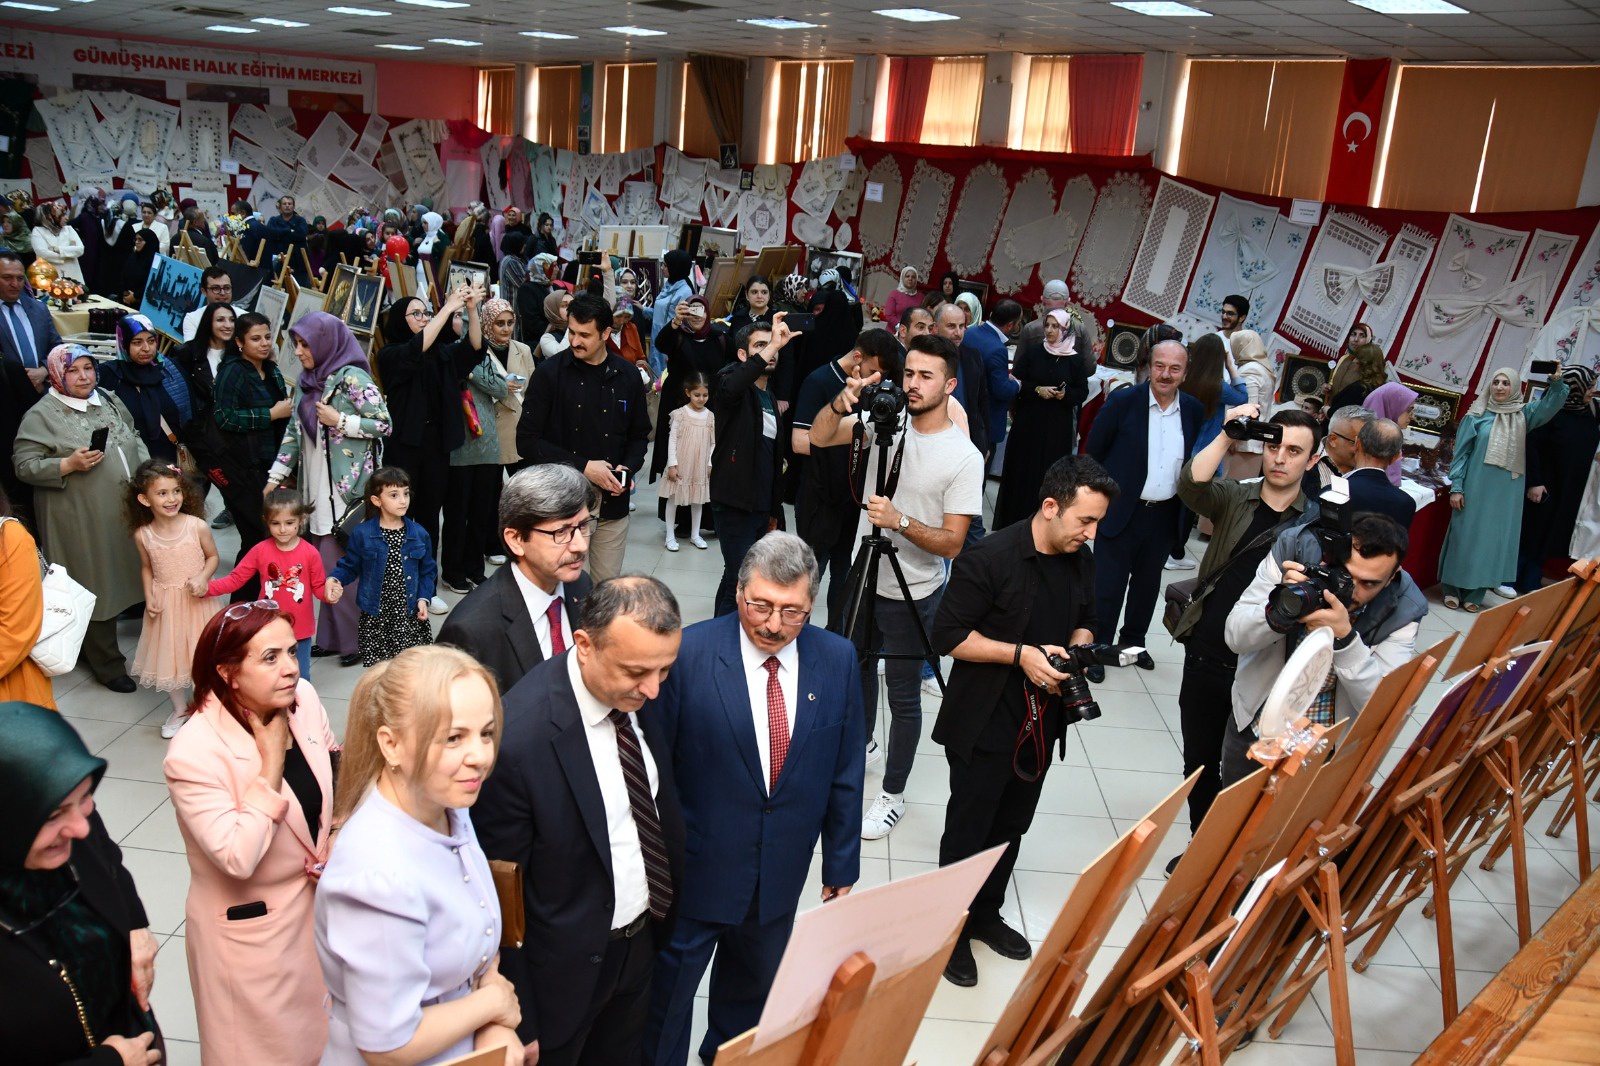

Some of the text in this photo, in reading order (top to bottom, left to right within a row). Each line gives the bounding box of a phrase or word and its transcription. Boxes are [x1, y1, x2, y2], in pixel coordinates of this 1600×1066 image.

[73, 46, 362, 85] GÜMÜŞHANE HALK EĞİTİM MERKEZİ
[1030, 694, 1038, 721] Canon
